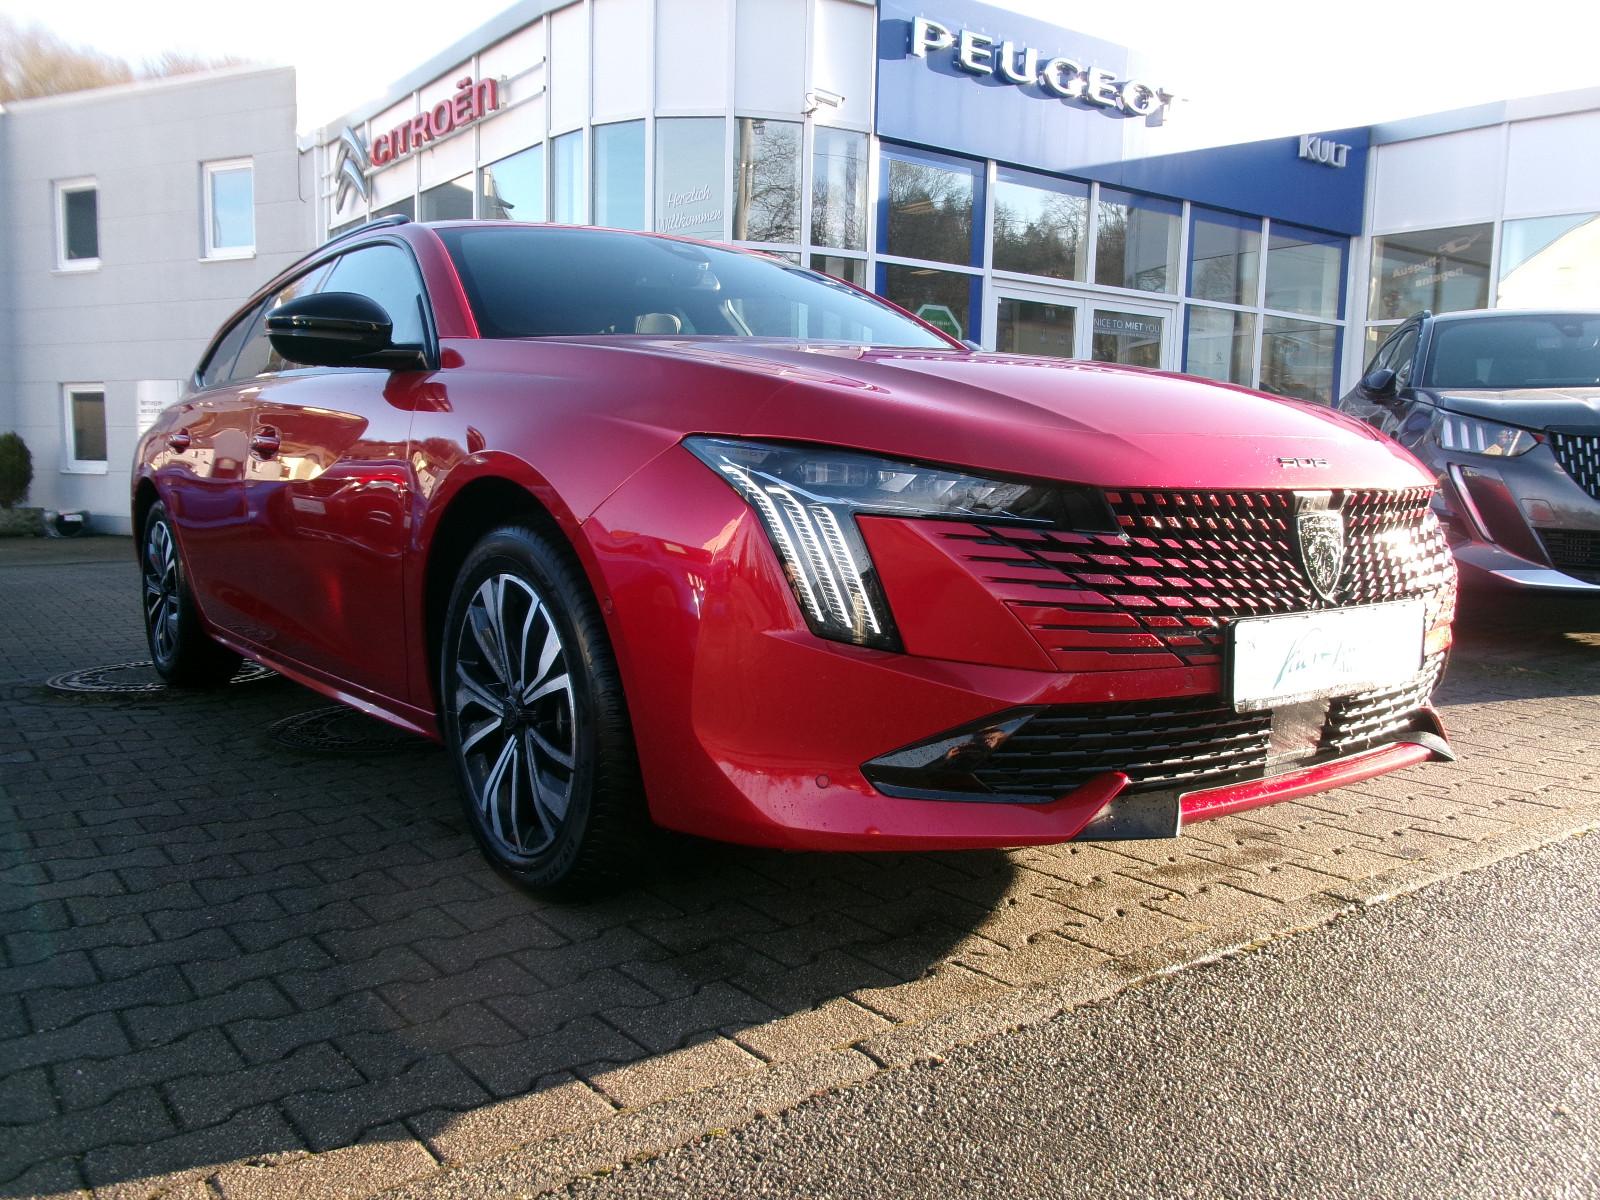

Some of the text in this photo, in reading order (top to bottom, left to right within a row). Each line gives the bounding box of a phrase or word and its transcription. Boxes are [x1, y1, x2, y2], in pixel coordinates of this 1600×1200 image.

[1299, 135, 1352, 168] KULT
[667, 184, 713, 208] Herzlich
[1094, 317, 1160, 332] NICE TO MIET YOU
